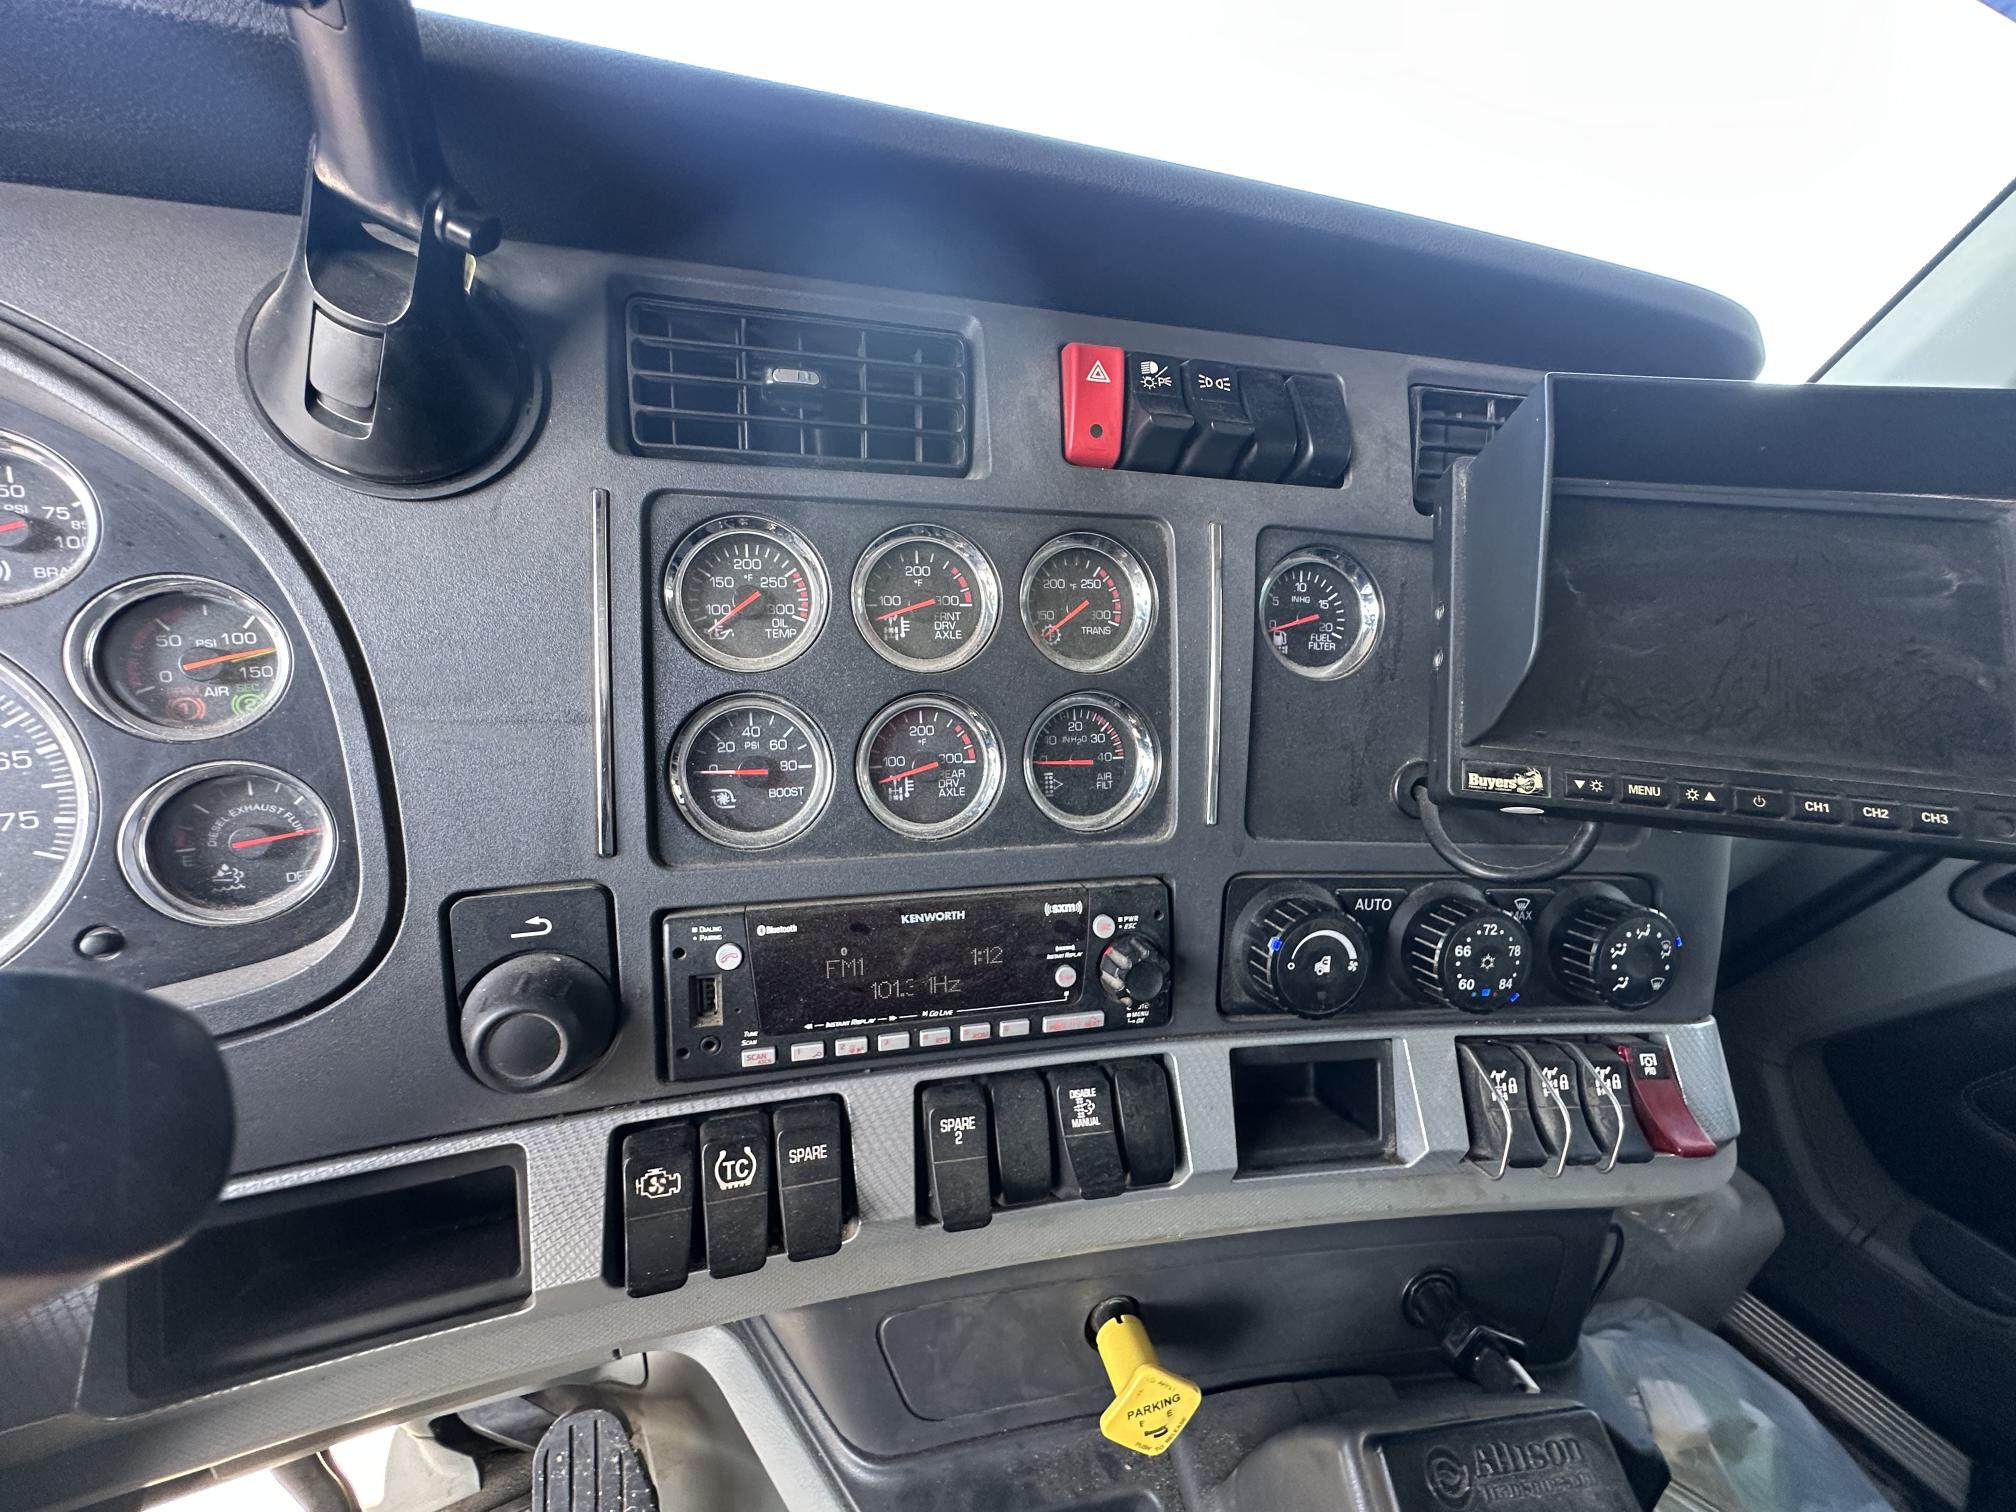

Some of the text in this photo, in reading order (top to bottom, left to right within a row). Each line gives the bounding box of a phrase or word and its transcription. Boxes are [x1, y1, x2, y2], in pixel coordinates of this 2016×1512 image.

[41, 506, 71, 520] 75
[733, 558, 762, 570] 200
[905, 565, 931, 577] 200
[709, 576, 735, 588] 150
[760, 576, 788, 588] 250
[1043, 578, 1066, 589] 200
[1080, 578, 1102, 589] 250
[1294, 582, 1307, 593] 10
[879, 595, 902, 606] 100
[935, 595, 960, 606] 300
[1272, 596, 1280, 606] 5
[1318, 599, 1330, 610] 15
[705, 603, 732, 616] 100
[767, 603, 795, 615] 300
[1091, 609, 1112, 621] 300
[934, 611, 962, 621] FRNT
[771, 618, 789, 628] OIL
[934, 621, 956, 631] DRV
[1319, 622, 1334, 633] 20
[764, 628, 797, 639] TEMP
[934, 630, 963, 640] AXLE
[1081, 626, 1112, 636] TRANS
[155, 634, 182, 648] 50
[195, 638, 217, 648] PSI
[221, 632, 257, 645] 100
[1310, 632, 1332, 643] FUEL
[1308, 641, 1336, 652] FILTER
[159, 670, 173, 683] 0
[239, 665, 274, 679] 150
[204, 685, 230, 698] AIR
[742, 726, 761, 738] 40
[909, 725, 935, 737] 200
[1068, 721, 1083, 732] 20
[1046, 735, 1057, 746] 10
[1090, 733, 1105, 744] 30
[717, 741, 736, 753] 20
[744, 741, 760, 750] PSI
[769, 739, 788, 751] 60
[883, 755, 906, 768] 100
[1097, 751, 1113, 762] 40
[780, 760, 798, 772] 80
[1097, 772, 1112, 781] AIR
[1468, 772, 1517, 790] Buyers
[938, 778, 960, 788] DRV
[1096, 781, 1113, 790] FILT
[768, 786, 804, 798] BOOST
[938, 786, 966, 797] AXLE
[1628, 784, 1661, 797] MENU
[1804, 801, 1830, 813] CH1
[1862, 806, 1889, 819] CH2
[0, 810, 40, 832] 75
[1921, 812, 1949, 825] CH3
[207, 815, 231, 847] DIESEL
[228, 803, 285, 818] EXHAUST
[1354, 898, 1392, 911] AUTO
[900, 910, 966, 925] KENWORTH
[766, 924, 798, 935] Bluetooth
[1483, 923, 1498, 936] 72
[971, 946, 1003, 966] 1:12
[1454, 945, 1472, 957] 66
[1508, 945, 1521, 957] 78
[826, 957, 864, 979] FM1
[1458, 978, 1475, 991] 60
[1498, 978, 1513, 990] 84
[1069, 1088, 1097, 1099] DISABLE
[940, 1116, 976, 1133] SPARE
[1071, 1116, 1101, 1128] MANUAL
[954, 1131, 963, 1145] 2
[788, 1144, 828, 1164] SPARE
[723, 1159, 749, 1180] TC
[1127, 1393, 1181, 1420] PARKING
